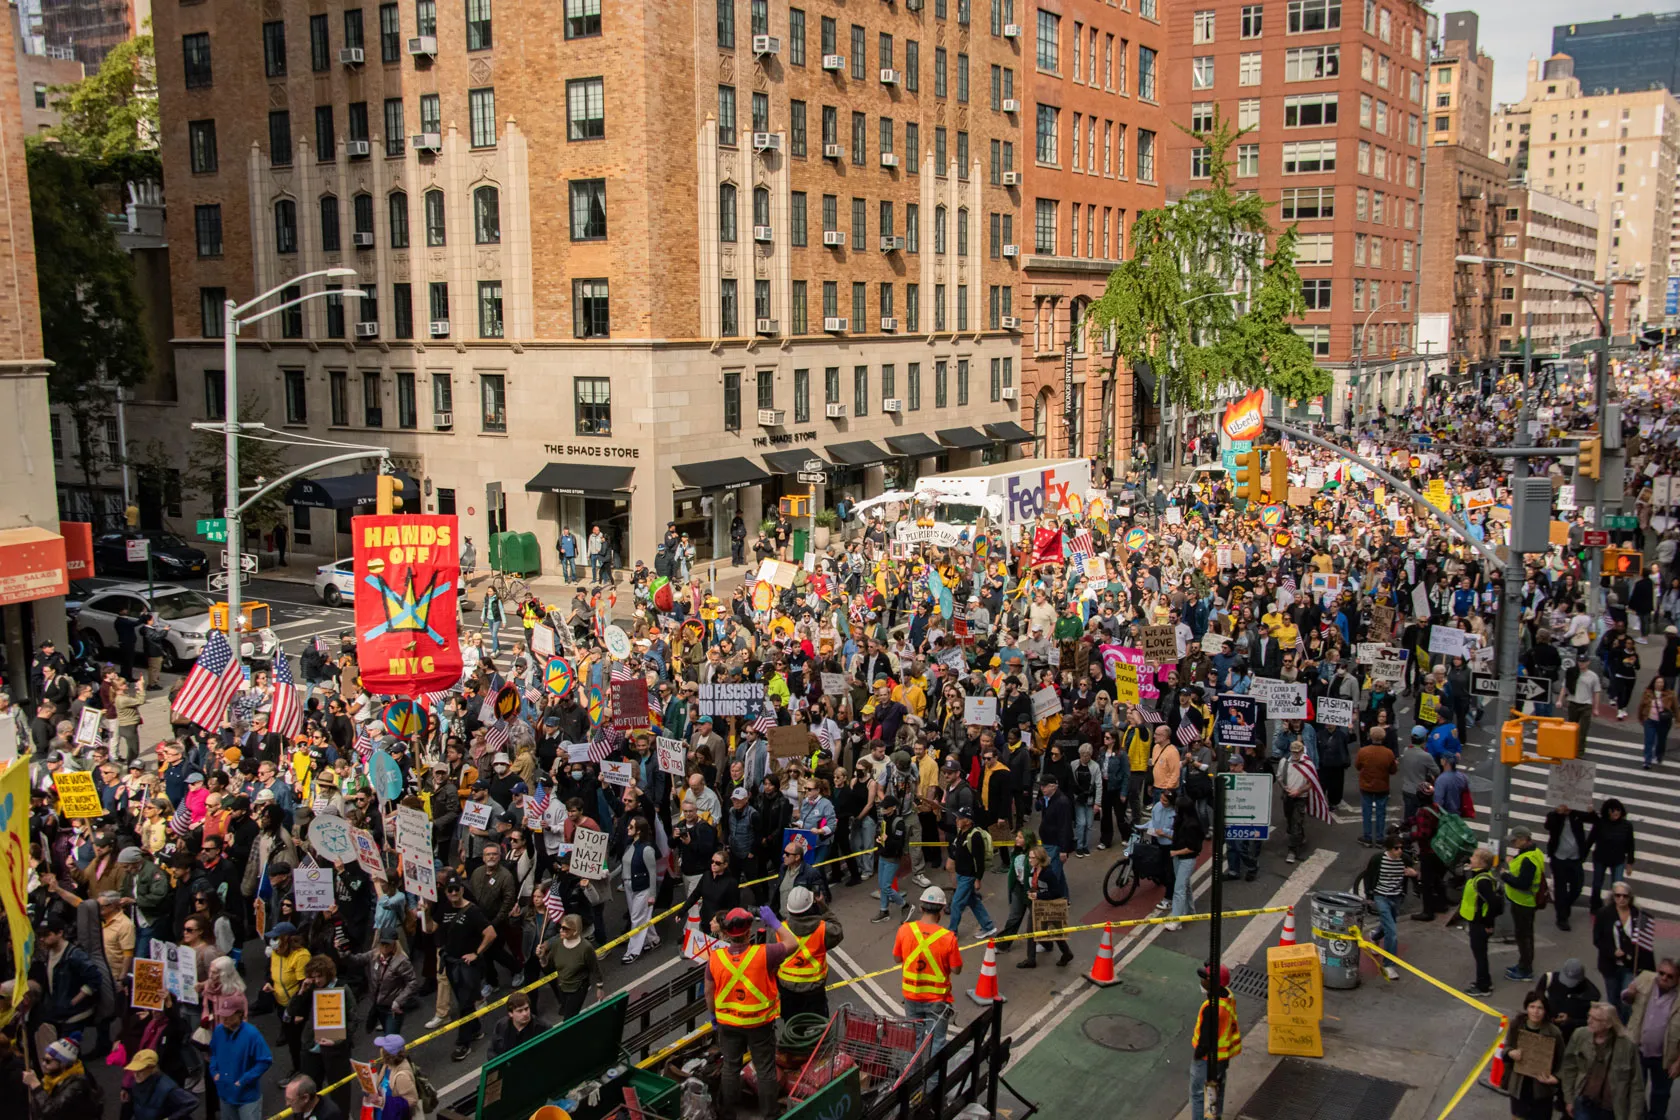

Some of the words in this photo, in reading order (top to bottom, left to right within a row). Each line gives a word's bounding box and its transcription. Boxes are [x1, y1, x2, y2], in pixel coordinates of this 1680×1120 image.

[1065, 345, 1073, 384] WILLIAMS
[1228, 410, 1260, 435] Liberty
[752, 437, 768, 448] THE
[769, 434, 793, 446] SHADE
[794, 431, 817, 442] STORE
[544, 444, 564, 454] THE
[567, 445, 601, 456] SHADE
[603, 447, 640, 458] STORE
[1007, 469, 1069, 522] FedEx
[205, 521, 210, 532] 7
[364, 525, 450, 548] HANDS
[906, 529, 940, 541] PLURIBUS
[389, 547, 430, 565] OFF
[24, 571, 57, 582] SALADS
[1160, 628, 1174, 636] ALL
[1146, 638, 1173, 648] LOVE
[1145, 649, 1177, 657] AMERICA
[389, 657, 435, 676] NYC
[699, 683, 713, 699] NO
[714, 683, 764, 699] FASCISTS
[698, 700, 713, 716] NO
[714, 700, 747, 716] KINGS
[1222, 700, 1250, 708] RESIST
[1319, 698, 1350, 711] FASHION
[624, 716, 649, 726] FUTURE
[56, 775, 70, 784] WE
[70, 775, 91, 784] WON
[578, 830, 607, 845] STOP
[576, 849, 602, 862] NAZI
